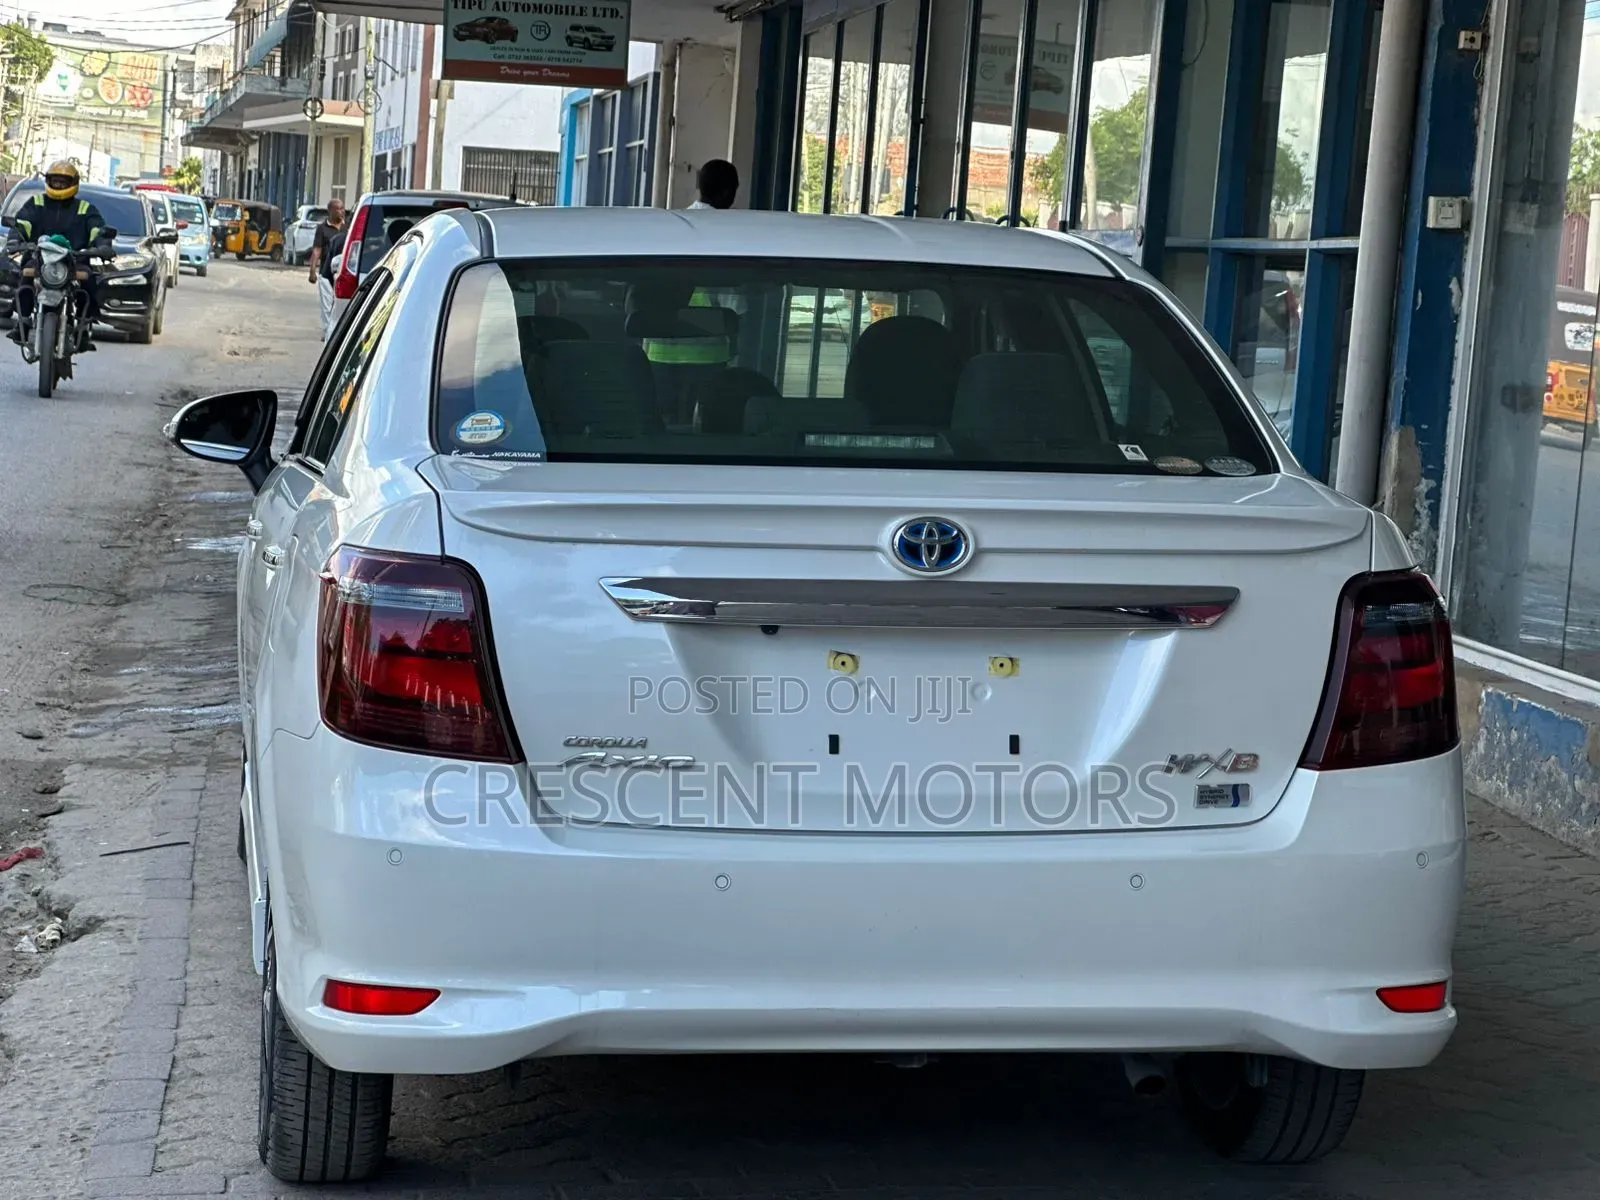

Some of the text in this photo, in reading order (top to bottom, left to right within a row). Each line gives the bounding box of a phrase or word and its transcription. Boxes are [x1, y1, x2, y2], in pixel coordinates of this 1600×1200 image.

[452, 0, 624, 19] TIPU AUTOMOBILE LTD.
[563, 735, 648, 749] COROLLA
